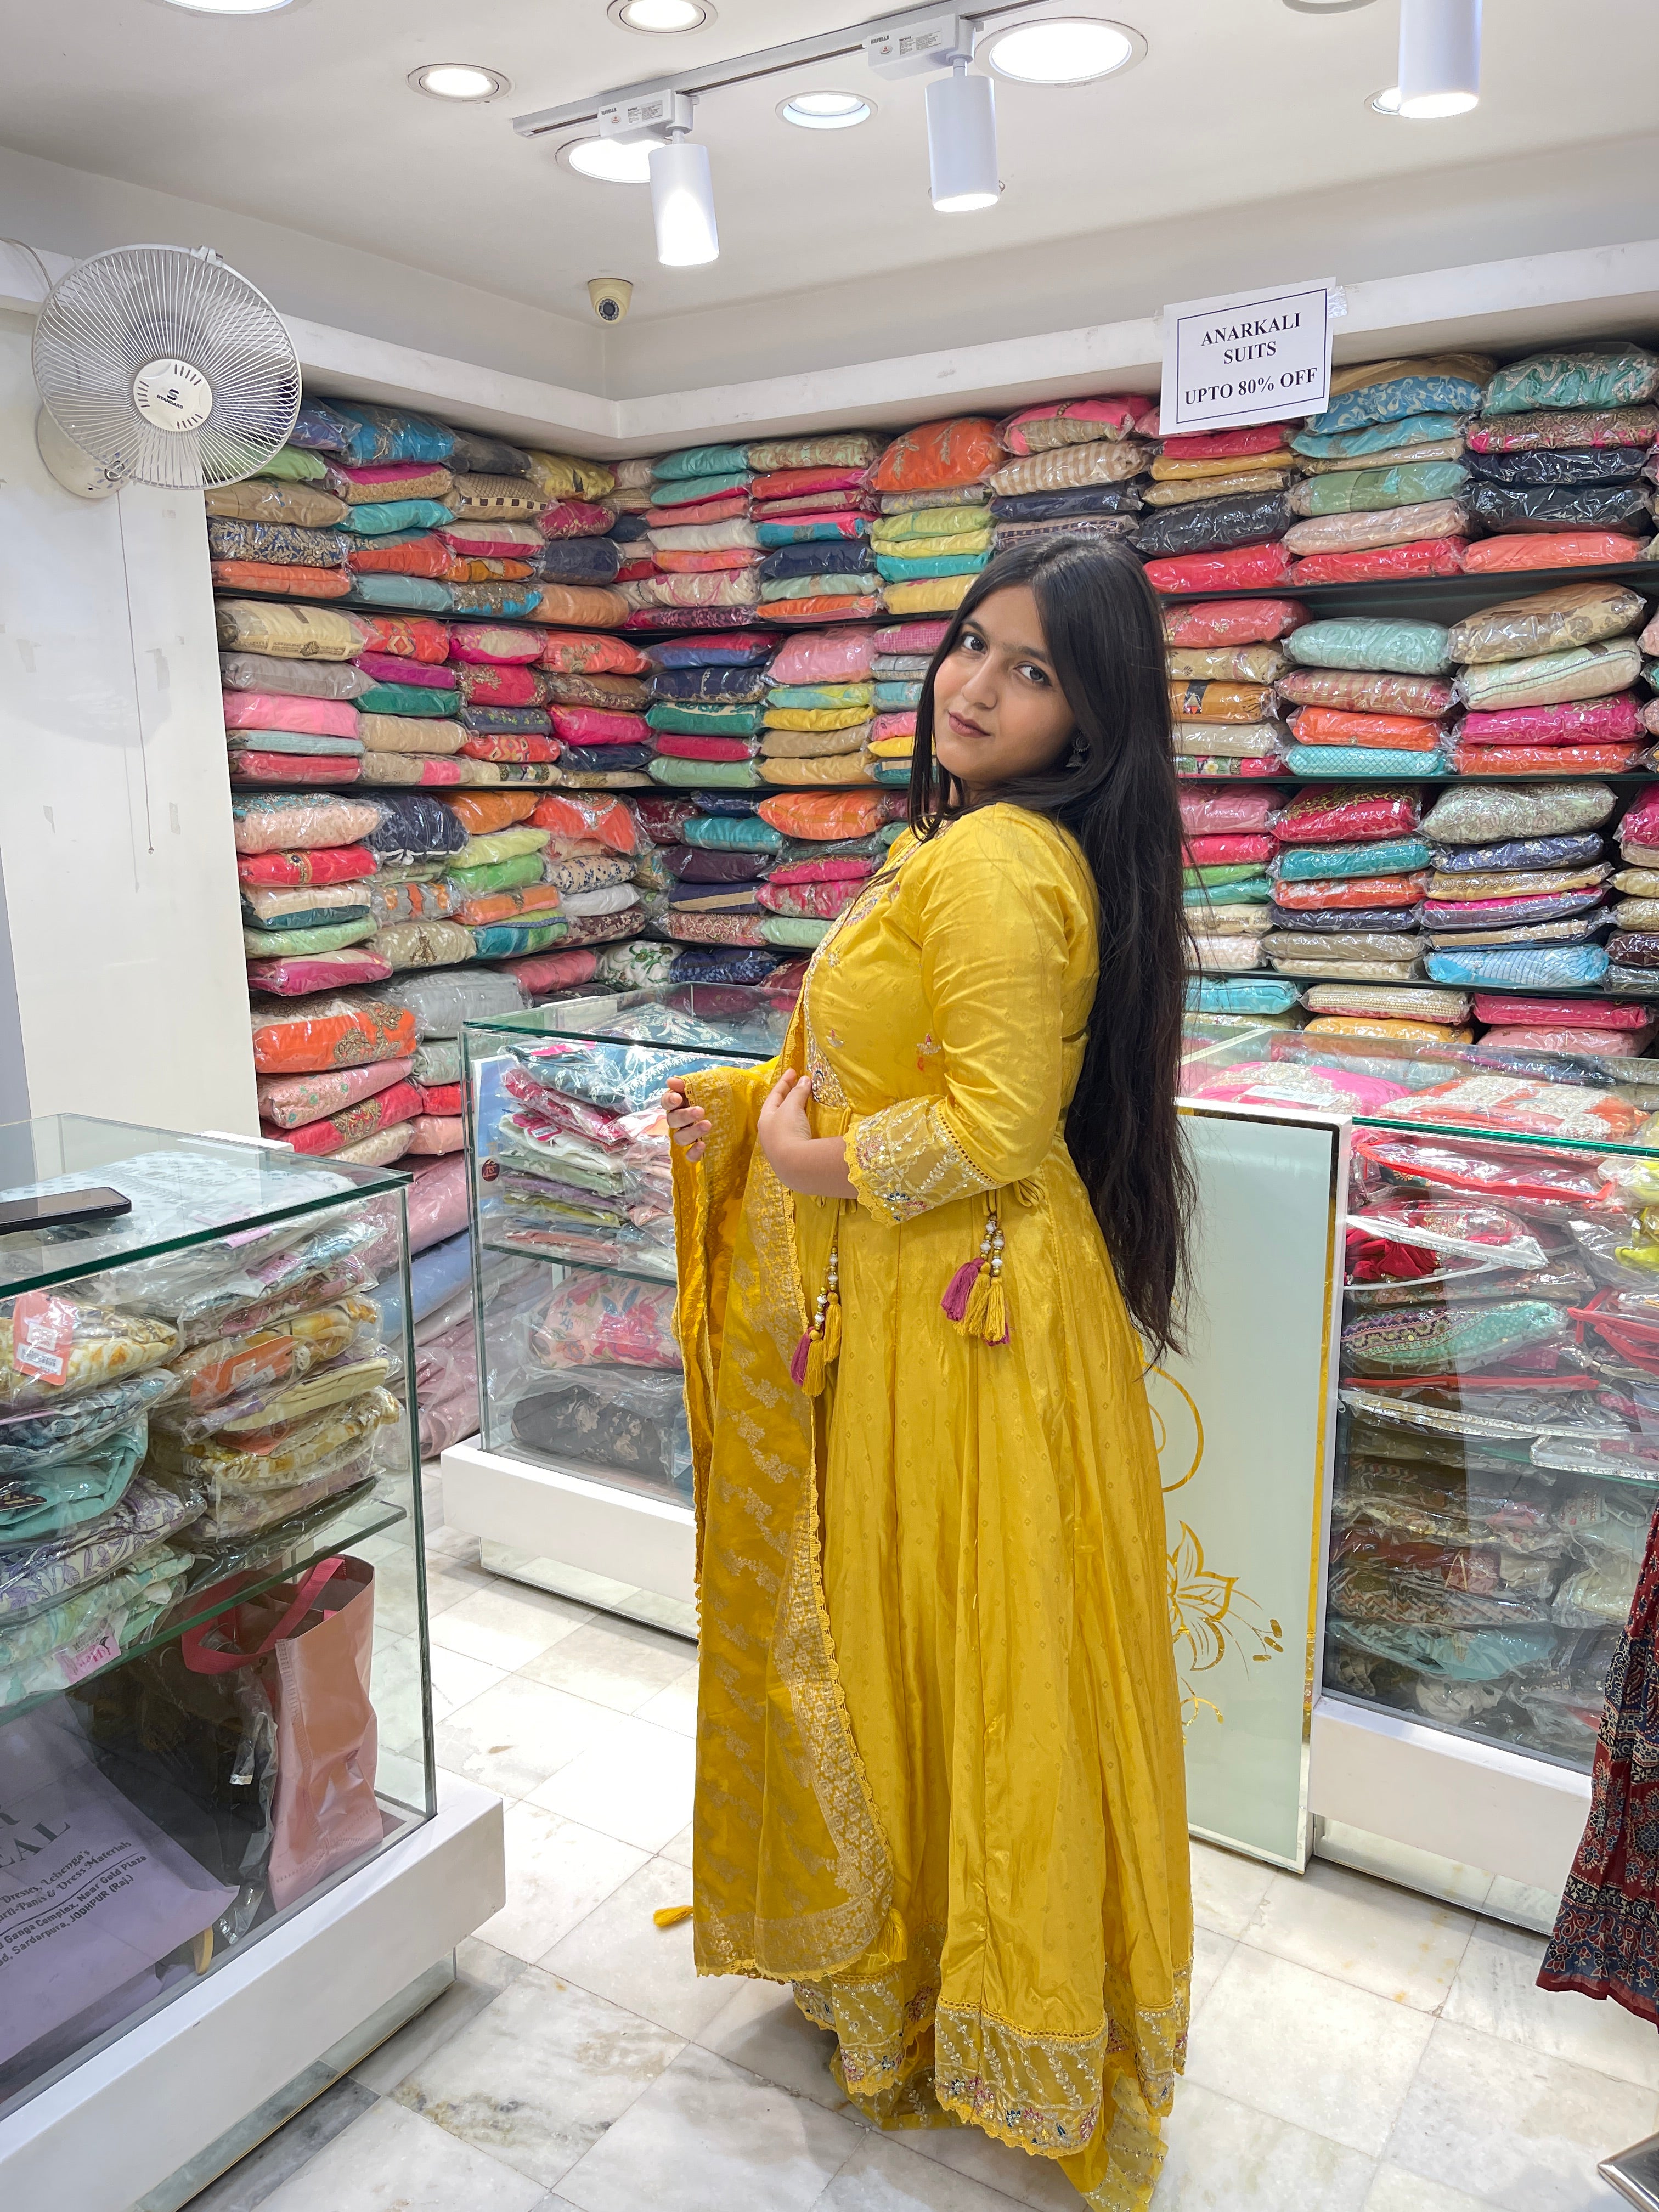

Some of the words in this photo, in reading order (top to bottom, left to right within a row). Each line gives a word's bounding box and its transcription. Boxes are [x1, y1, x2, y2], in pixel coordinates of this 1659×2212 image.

[1200, 312, 1302, 346] ANARKALI
[1223, 341, 1277, 365] SUITS
[1184, 383, 1233, 405] UPTO
[1238, 376, 1274, 396] 80%
[1280, 367, 1318, 388] OFF
[1, 1885, 43, 1904] Dresses,
[41, 1849, 90, 1886] Lehenga's
[56, 1867, 86, 1890] Dress
[84, 1841, 132, 1870] Materials
[4, 1924, 36, 1944] Ganga
[35, 1903, 79, 1927] Complex,
[77, 1883, 100, 1902] Near
[100, 1868, 122, 1884] Gold
[121, 1855, 147, 1870] Plaza
[12, 1921, 70, 1955] Sardarpura,
[70, 1891, 110, 1922] JODHPUR
[109, 1874, 134, 1893] (Raj.)
